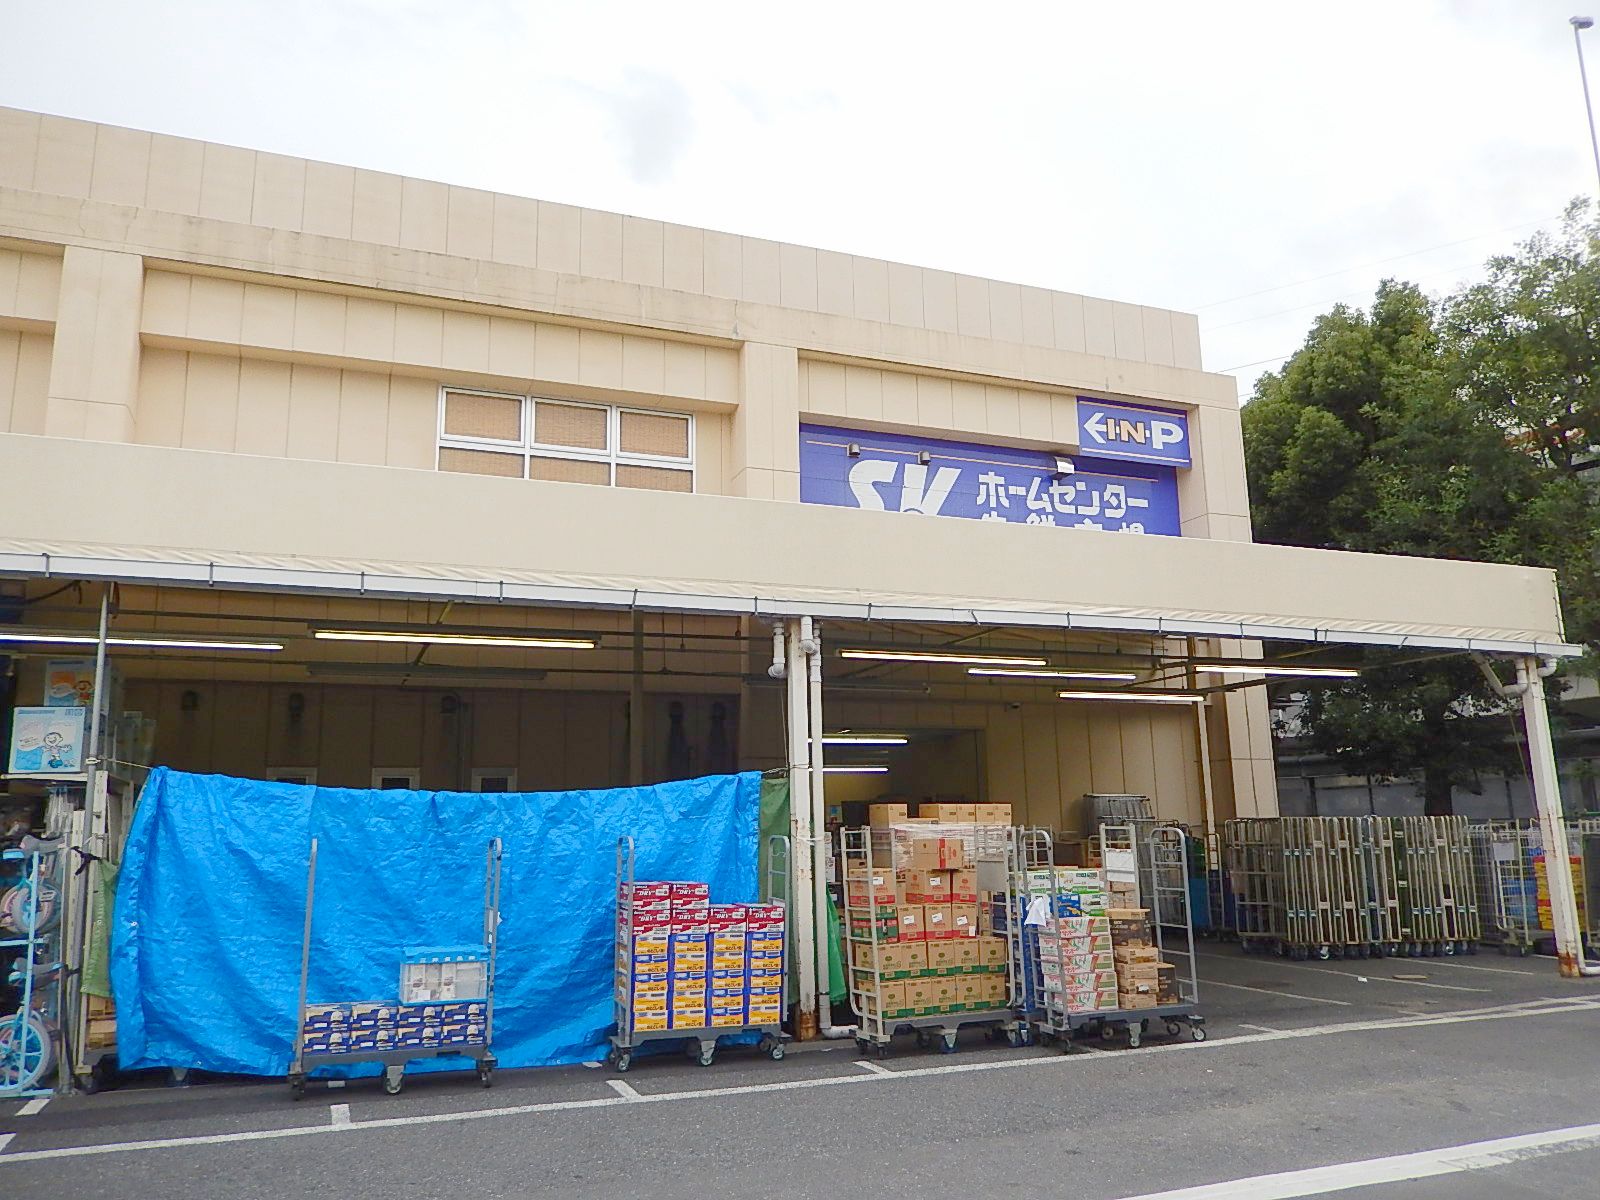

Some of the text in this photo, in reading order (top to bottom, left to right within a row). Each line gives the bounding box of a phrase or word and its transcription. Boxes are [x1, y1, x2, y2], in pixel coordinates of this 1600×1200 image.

[976, 471, 1149, 519] ホームセンター
